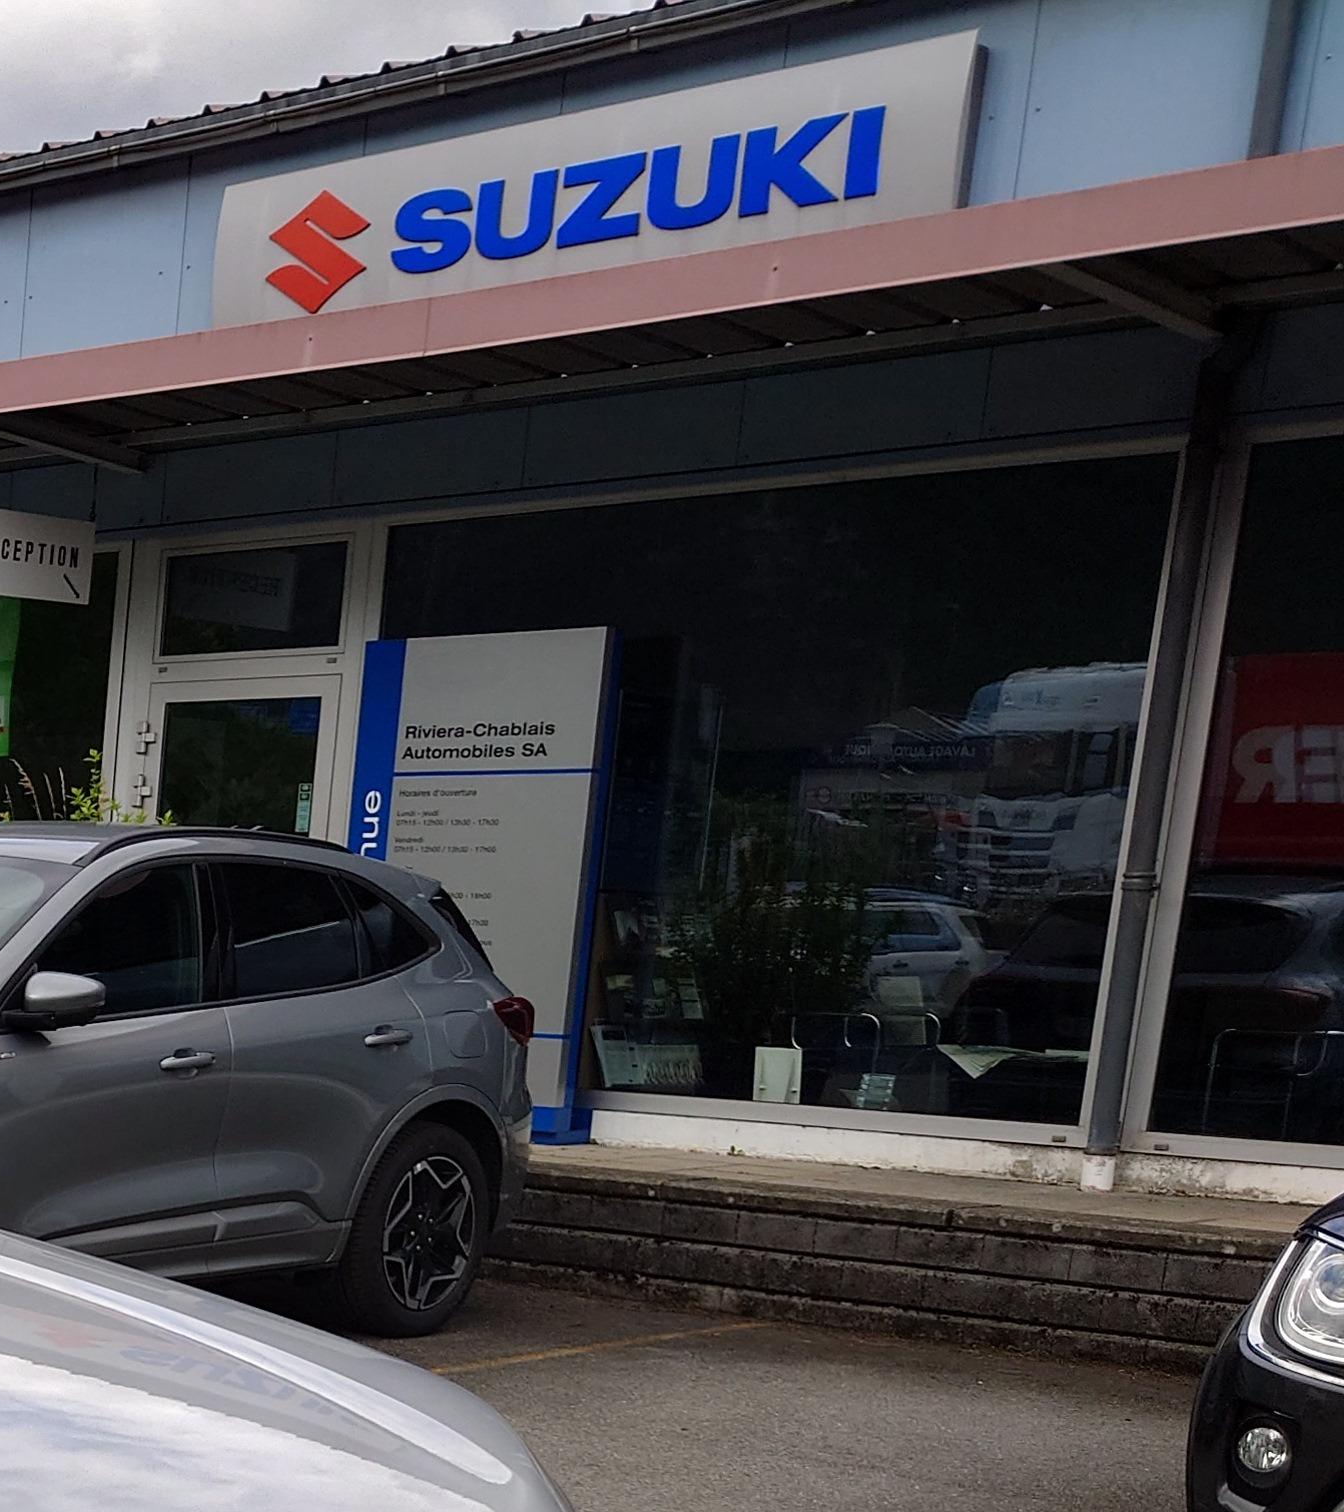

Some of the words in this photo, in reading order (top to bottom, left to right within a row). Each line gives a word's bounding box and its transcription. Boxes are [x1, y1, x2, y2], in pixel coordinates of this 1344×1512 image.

[391, 104, 887, 274] SUZUKI
[404, 721, 556, 740] Riviera-Chablais
[401, 744, 516, 761] Automobiles
[521, 742, 549, 758] SA
